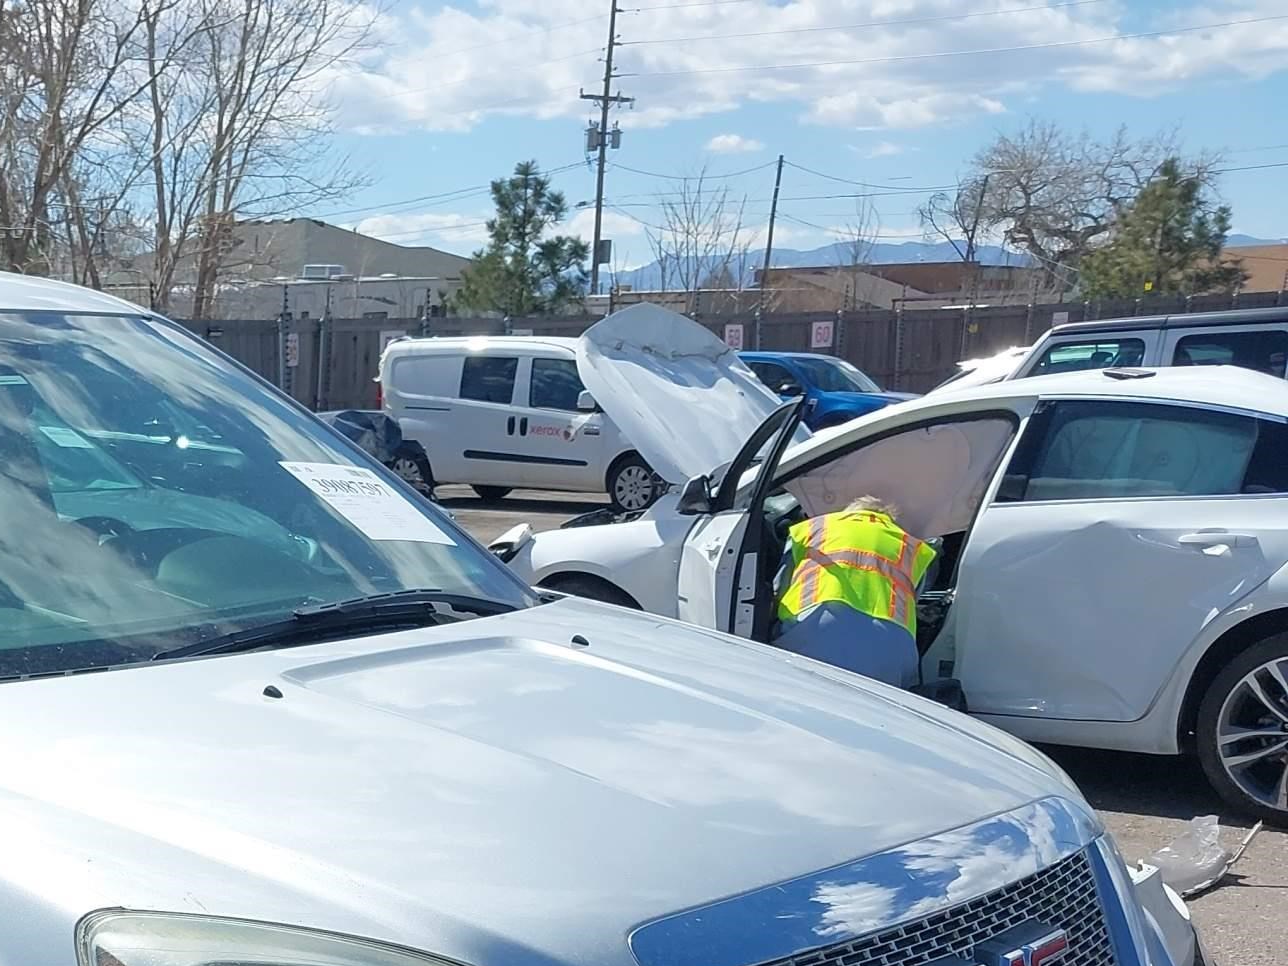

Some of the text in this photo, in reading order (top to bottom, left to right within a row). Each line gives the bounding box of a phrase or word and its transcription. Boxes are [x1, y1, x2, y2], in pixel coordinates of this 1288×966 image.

[815, 326, 832, 344] 60
[529, 424, 562, 437] xerox
[312, 478, 391, 498] 39087597
